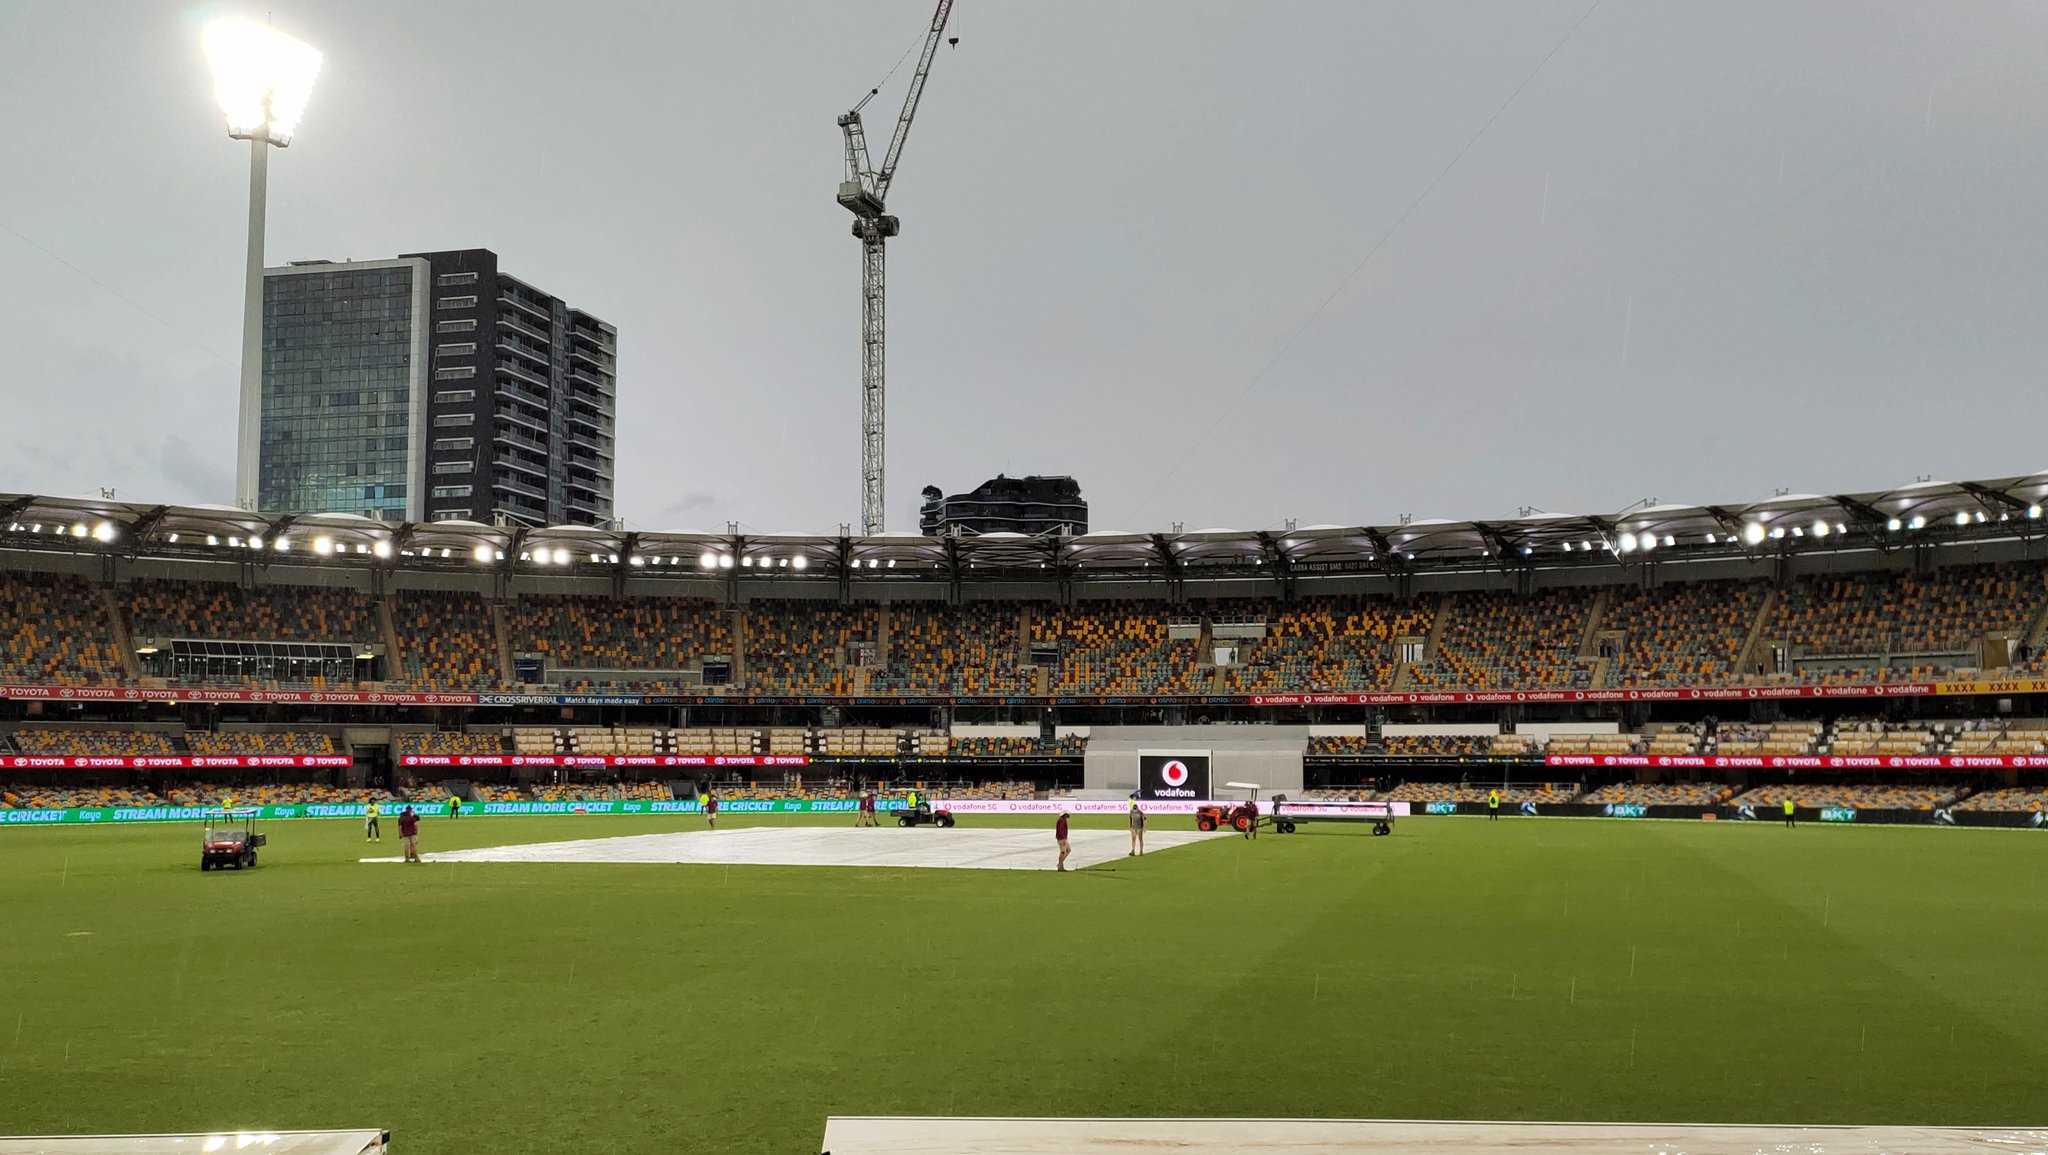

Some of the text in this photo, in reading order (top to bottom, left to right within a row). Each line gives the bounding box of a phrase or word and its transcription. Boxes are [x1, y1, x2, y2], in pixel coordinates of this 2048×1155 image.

[1761, 687, 1801, 696] vodafone
[1826, 686, 1868, 696] vodafone
[1887, 685, 1929, 694] vodafone
[1946, 684, 1976, 693] XXXX
[1988, 682, 2019, 692] XXXX
[10, 688, 49, 698] TOYOTA
[77, 689, 115, 698] TOYOTA
[142, 690, 178, 699] TOYOTA
[204, 691, 240, 700] TOYOTA
[266, 692, 301, 701] TOYOTA
[324, 693, 360, 702] TOYOTA
[1477, 693, 1511, 701] vodafone
[1529, 692, 1564, 700] vodafone
[1587, 690, 1624, 699] vodafone
[1642, 690, 1679, 698] vodafone
[1703, 689, 1742, 698] vodafone
[382, 694, 417, 703] TOYOTA
[438, 695, 473, 704] TOYOTA
[564, 696, 640, 707] Match days made easy
[1265, 696, 1298, 704] vodafone
[1314, 695, 1348, 703] vodafone
[1370, 695, 1404, 703] vodafone
[1421, 694, 1455, 702] vodafone
[30, 758, 65, 766] TOYOTA
[90, 758, 124, 766] TOYOTA
[147, 758, 182, 766] TOYOTA
[206, 758, 239, 766] TOYOTA
[261, 757, 294, 766] TOYOTA
[316, 757, 348, 765] TOYOTA
[419, 757, 451, 765] TOYOTA
[472, 757, 503, 765] TOYOTA
[525, 757, 555, 765] TOYOTA
[576, 757, 606, 765] TOYOTA
[626, 757, 656, 765] TOYOTA
[677, 757, 706, 765] TOYOTA
[726, 757, 756, 765] TOYOTA
[775, 757, 804, 765] TOYOTA
[1564, 757, 1595, 765] TOYOTA
[1618, 757, 1649, 766] TOYOTA
[1672, 757, 1705, 766] TOYOTA
[1729, 757, 1763, 766] TOYOTA
[1786, 757, 1821, 766] TOYOTA
[1846, 757, 1881, 766] TOYOTA
[1904, 758, 1941, 766] TOYOTA
[1966, 758, 2003, 767] TOYOTA
[1154, 788, 1196, 798] vodafone
[306, 805, 356, 817] STREAM
[357, 804, 392, 816] MRE
[483, 801, 614, 814] STREAM MORE CRICKET
[623, 802, 642, 814] Kayo
[650, 801, 696, 812] STREAM
[730, 800, 775, 812] CRICKET
[811, 801, 855, 812] STREAM
[952, 802, 998, 811] vodafone 5G
[1017, 802, 1063, 811] vodafone 5G
[1083, 803, 1128, 812] vodafone 5G
[1148, 803, 1194, 812] vodafone 5G
[8, 809, 66, 822] CRICKET
[79, 809, 102, 822] Kayo
[113, 807, 167, 820] STREAM
[274, 807, 295, 818] Kayo
